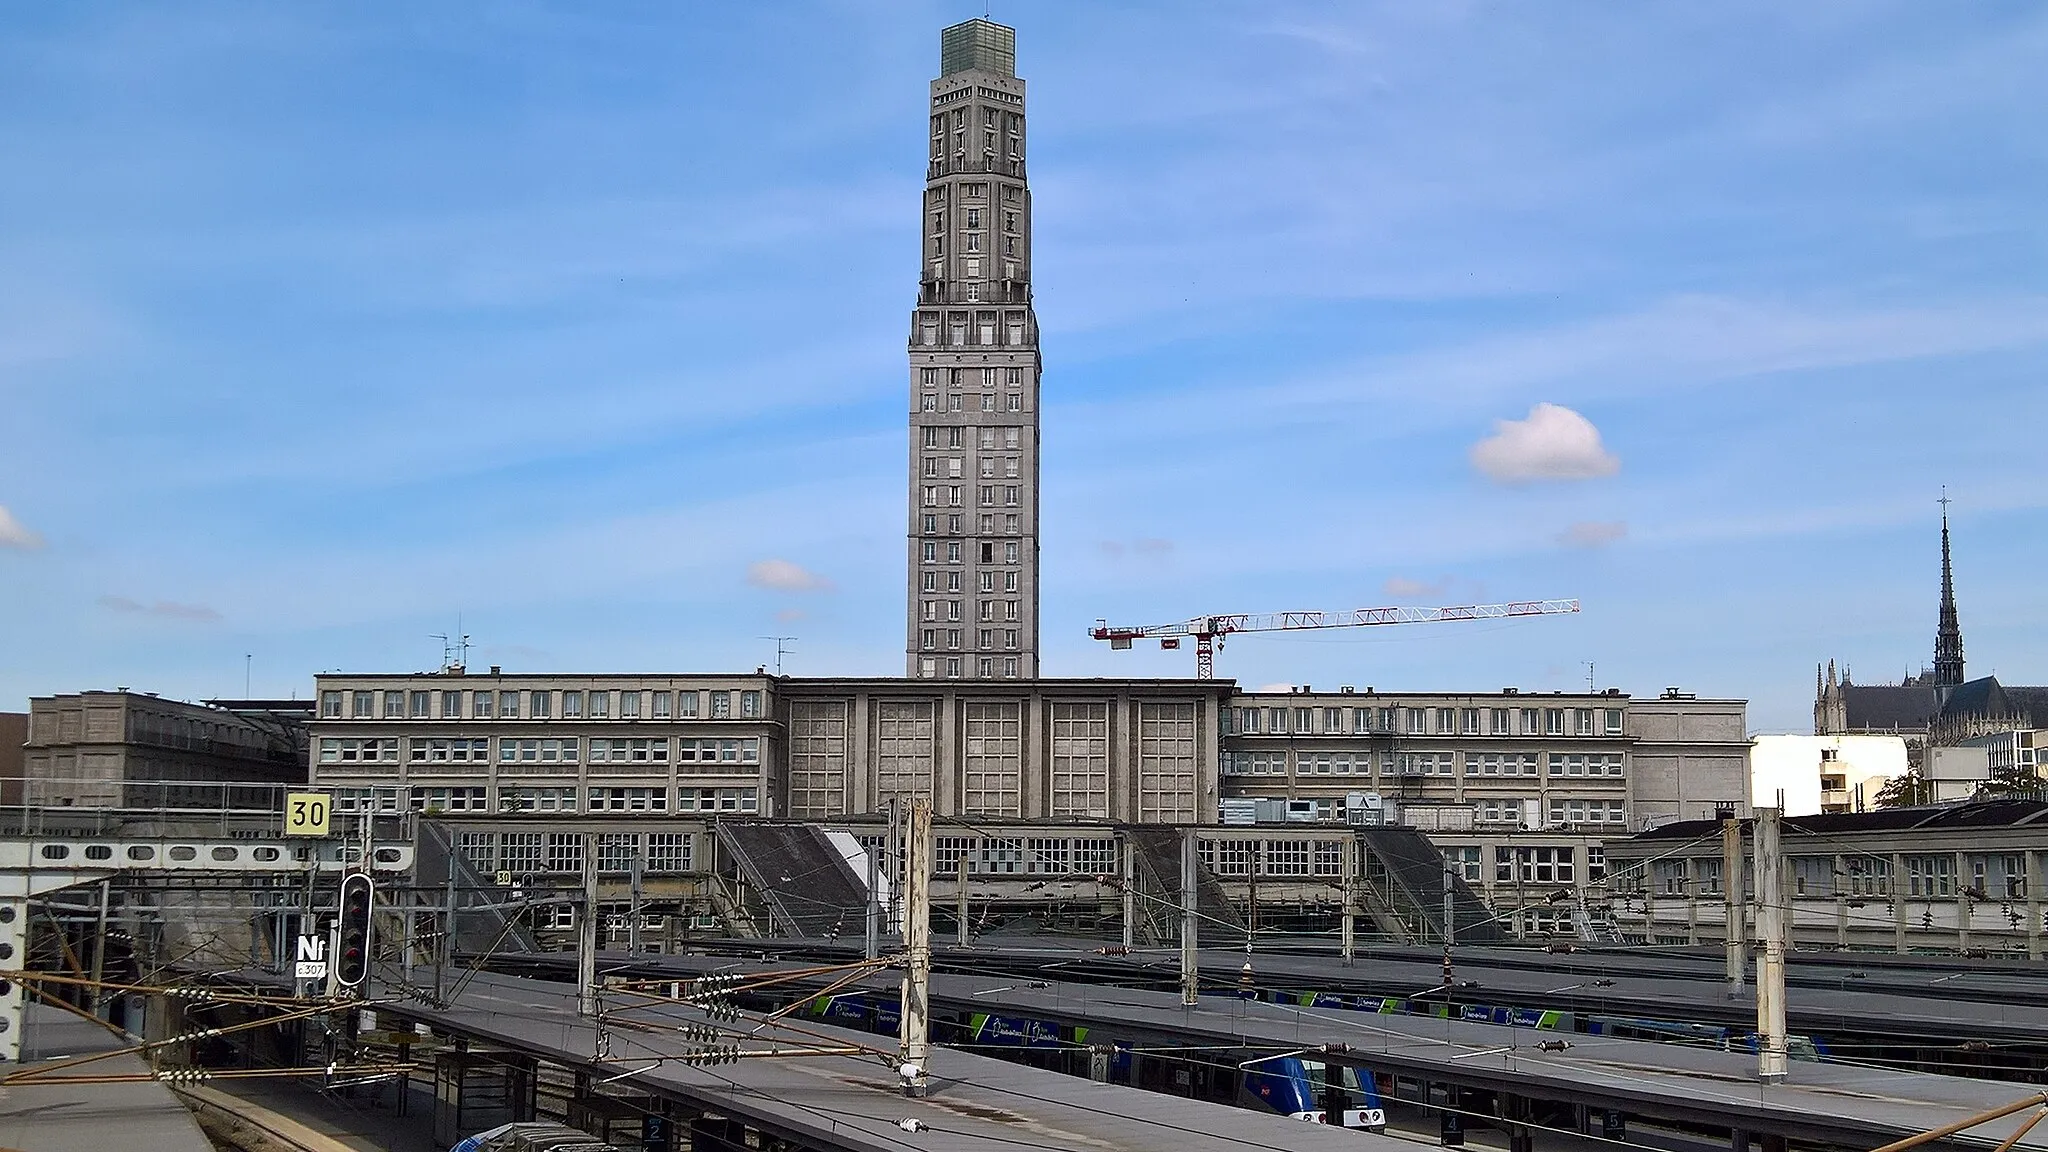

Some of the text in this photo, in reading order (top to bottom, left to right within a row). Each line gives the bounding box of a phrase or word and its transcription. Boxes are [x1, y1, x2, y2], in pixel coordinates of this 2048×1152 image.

[292, 801, 324, 826] 30
[498, 872, 510, 883] 30
[297, 935, 326, 961] Nf
[1448, 1117, 1457, 1131] 4
[1610, 1114, 1619, 1128] 5
[650, 1125, 660, 1139] 2
